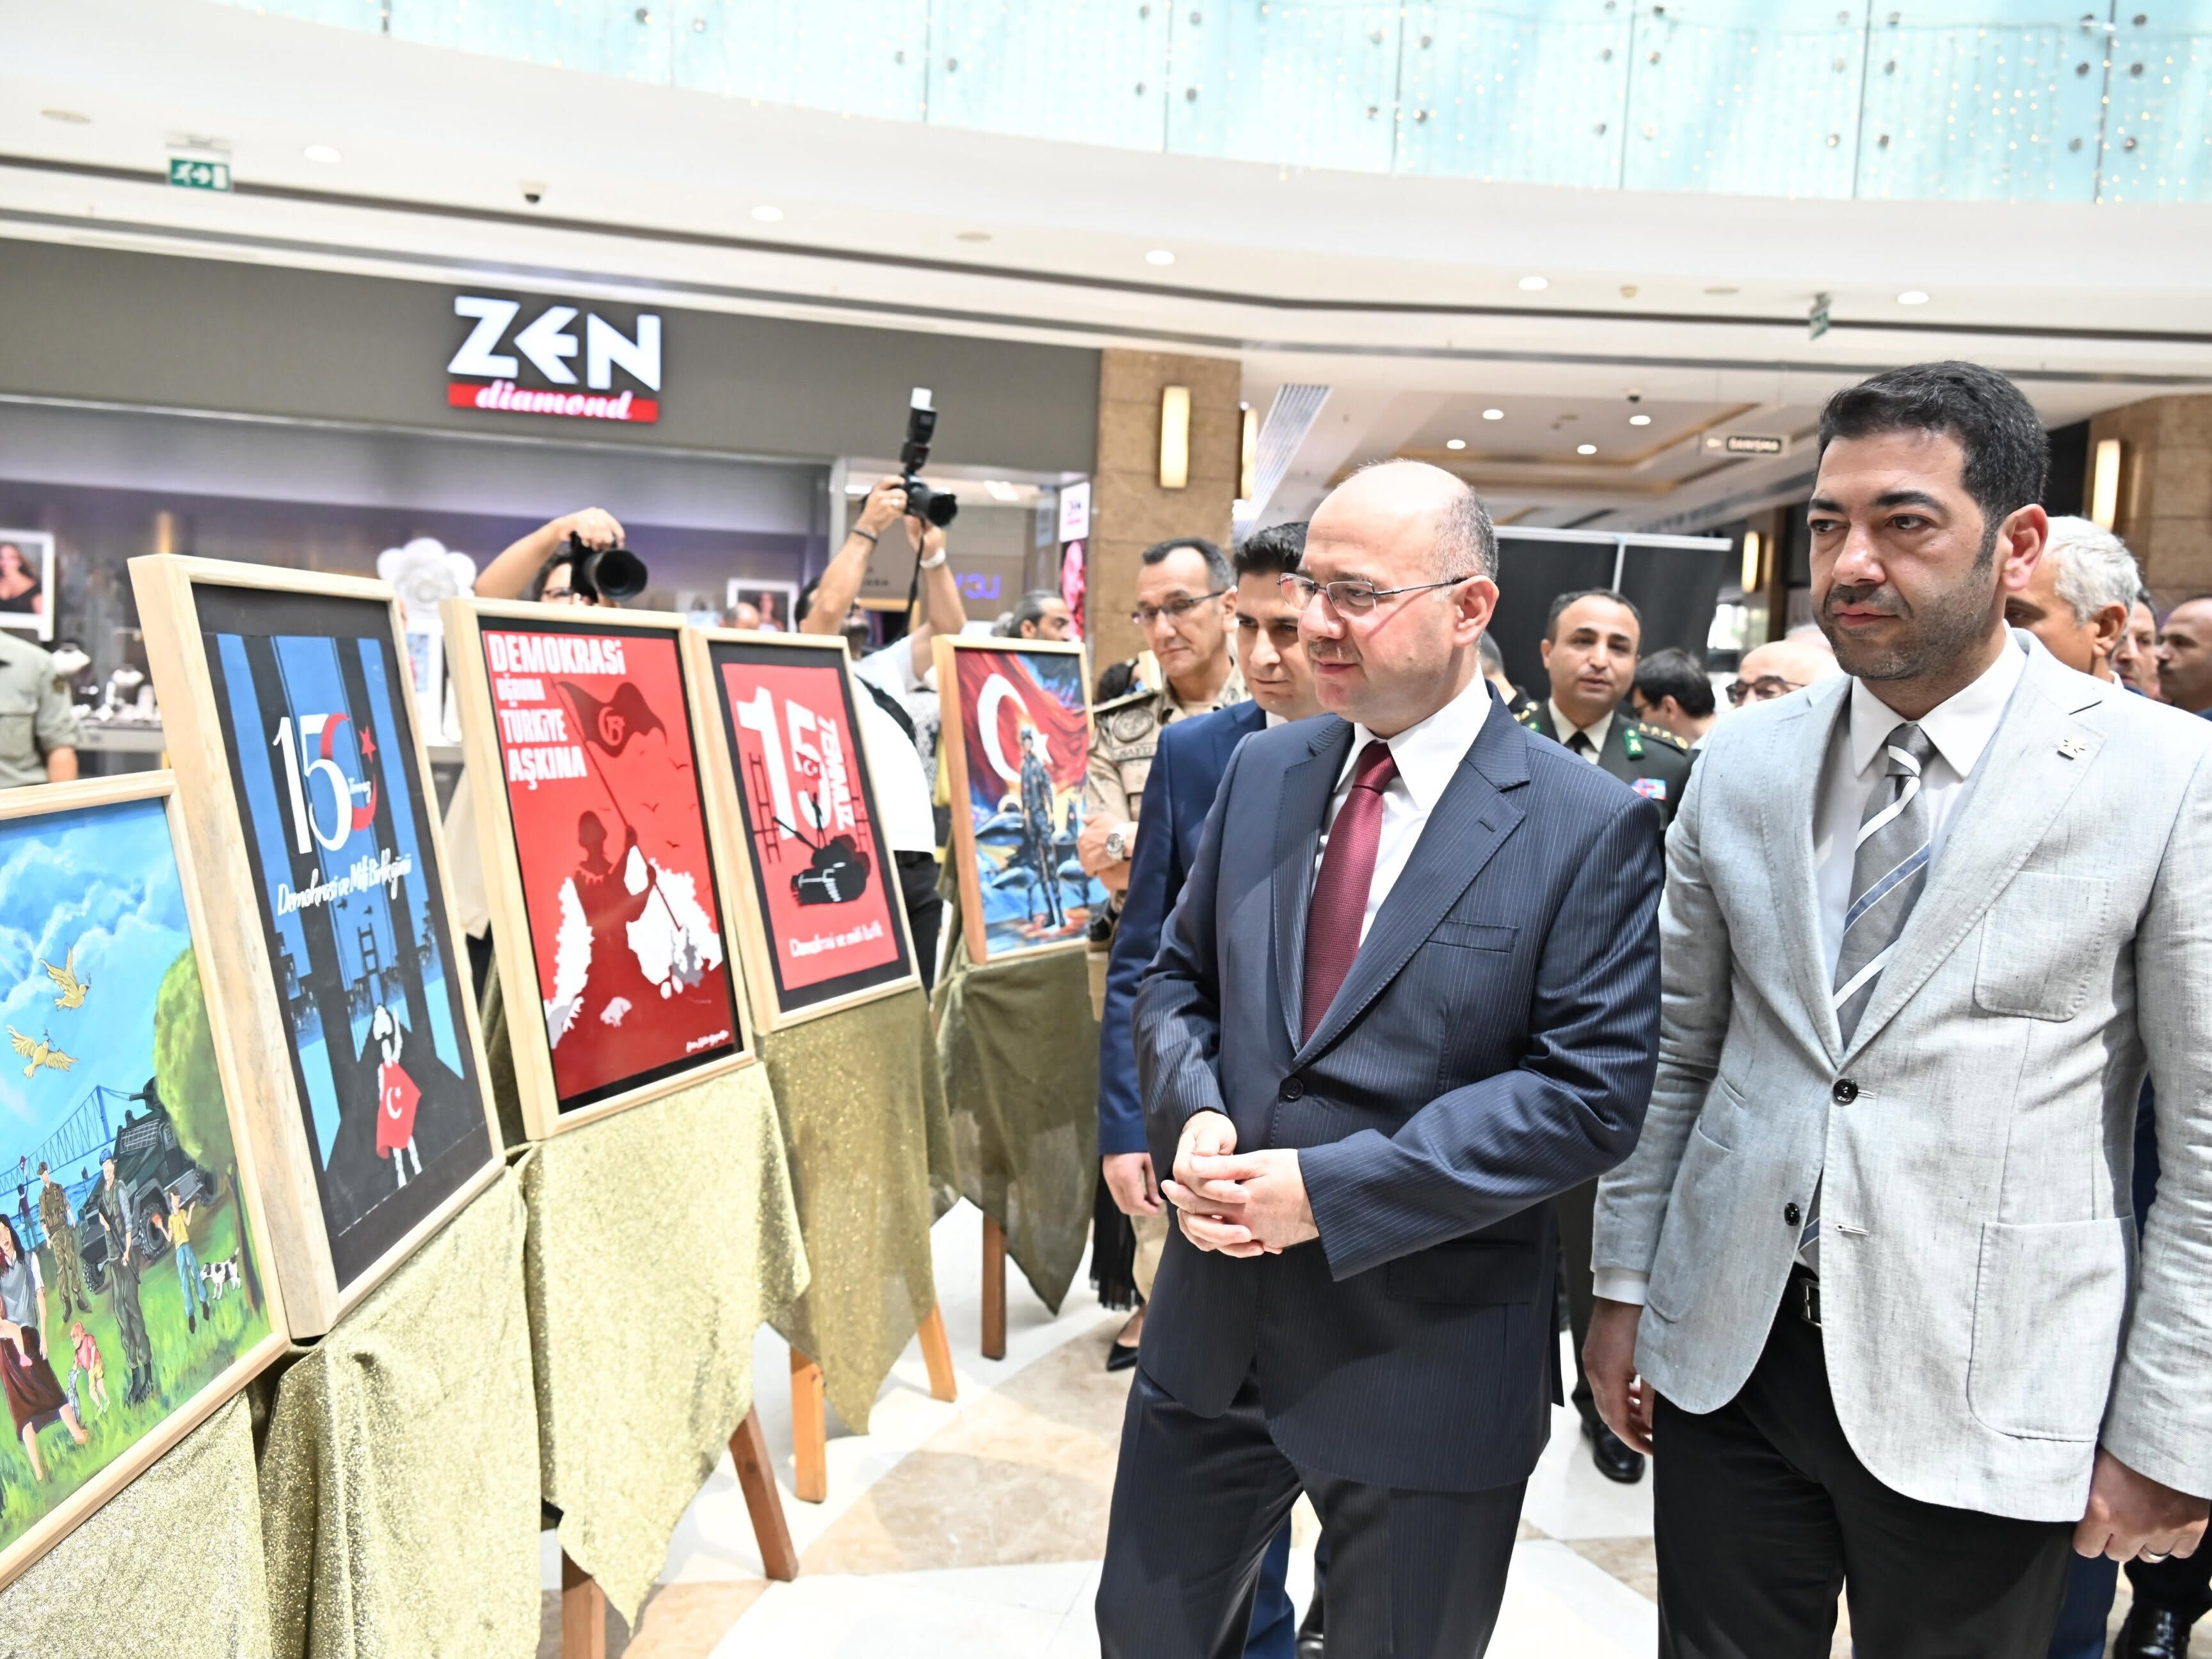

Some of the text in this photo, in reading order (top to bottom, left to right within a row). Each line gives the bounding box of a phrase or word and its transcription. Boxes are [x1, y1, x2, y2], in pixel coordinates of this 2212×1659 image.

[447, 296, 661, 392] ZEN
[475, 379, 633, 420] diamond
[272, 713, 353, 854] 15
[508, 746, 588, 790] AŞKINA
[736, 685, 831, 840] 15
[817, 716, 856, 831] TEMMUZ
